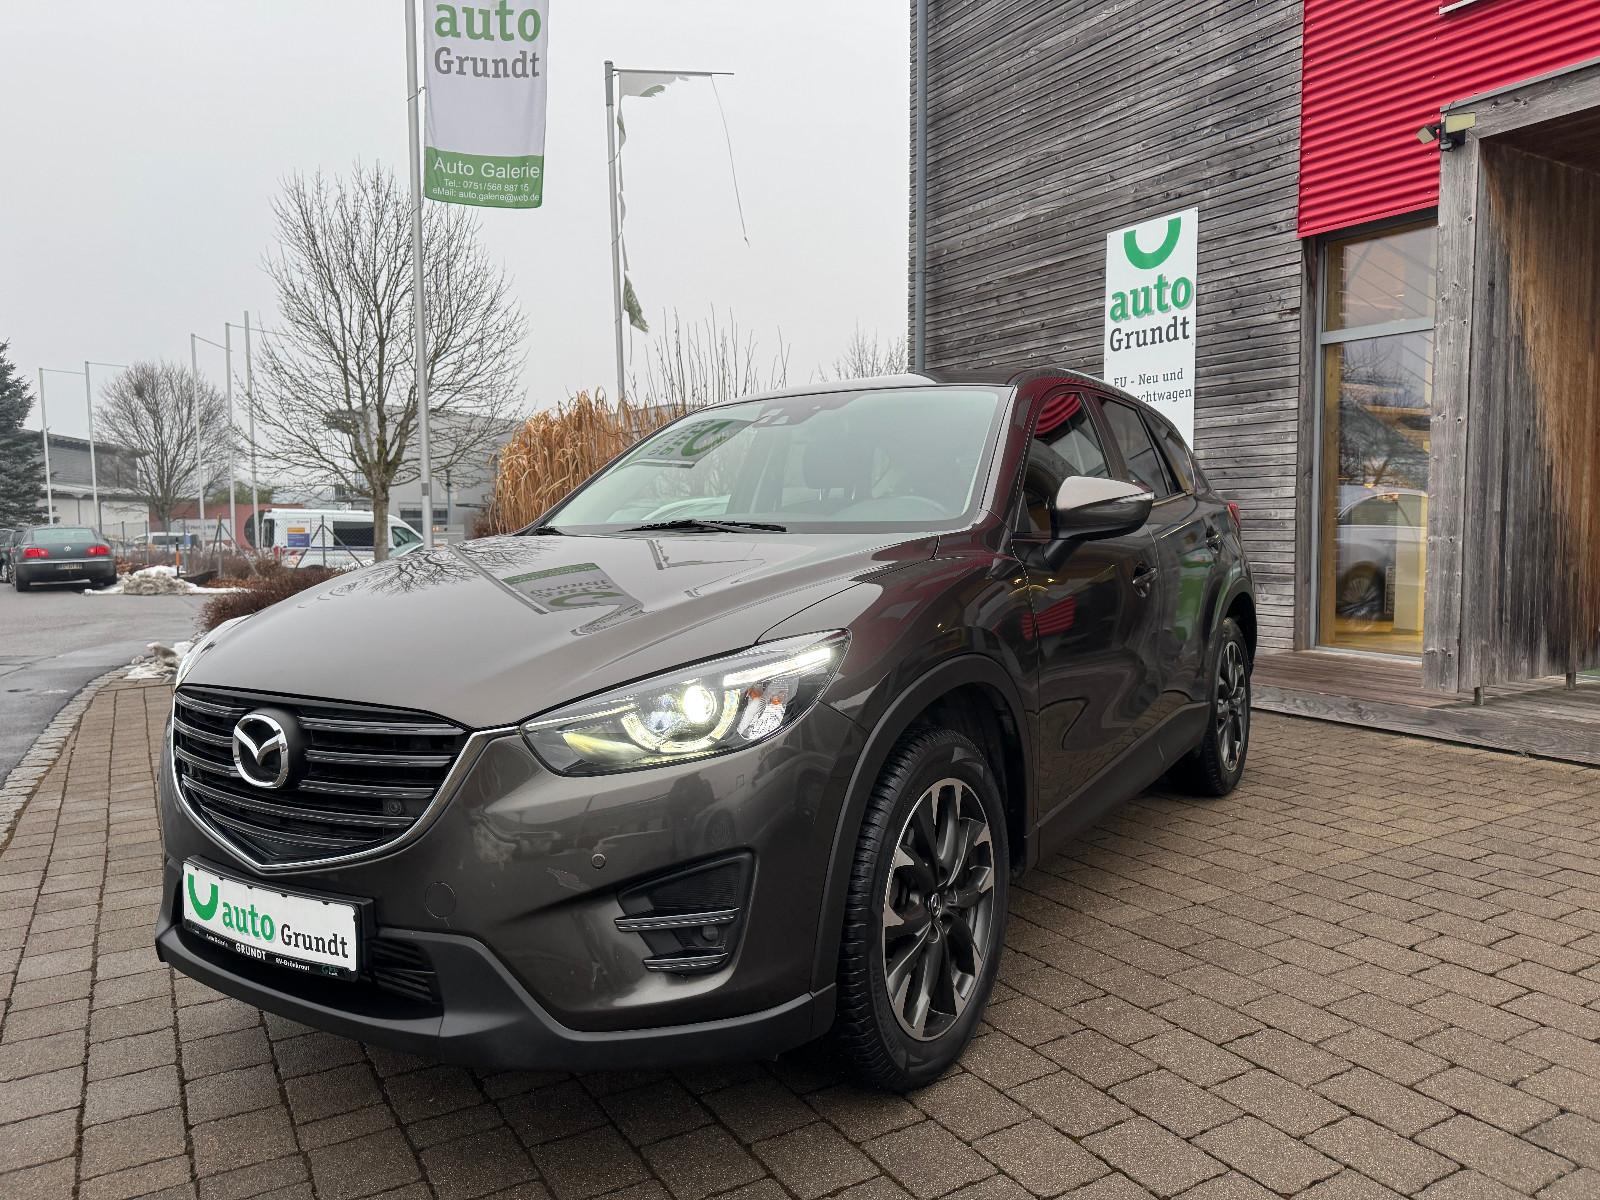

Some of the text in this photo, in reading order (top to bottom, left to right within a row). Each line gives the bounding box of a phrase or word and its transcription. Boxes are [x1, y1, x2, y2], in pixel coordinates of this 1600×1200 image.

[434, 0, 541, 42] auto
[434, 46, 539, 79] Grundt
[433, 156, 540, 179] Auto Galerie
[432, 186, 456, 197] eMail:
[443, 178, 461, 188] Tel.:
[1109, 273, 1193, 323] auto
[1109, 316, 1190, 352] Grundt
[1113, 376, 1127, 388] EU
[1138, 373, 1158, 385] Neu
[1162, 367, 1183, 382] und
[222, 900, 349, 959] auto Grundt
[235, 942, 266, 961] GRUNDT
